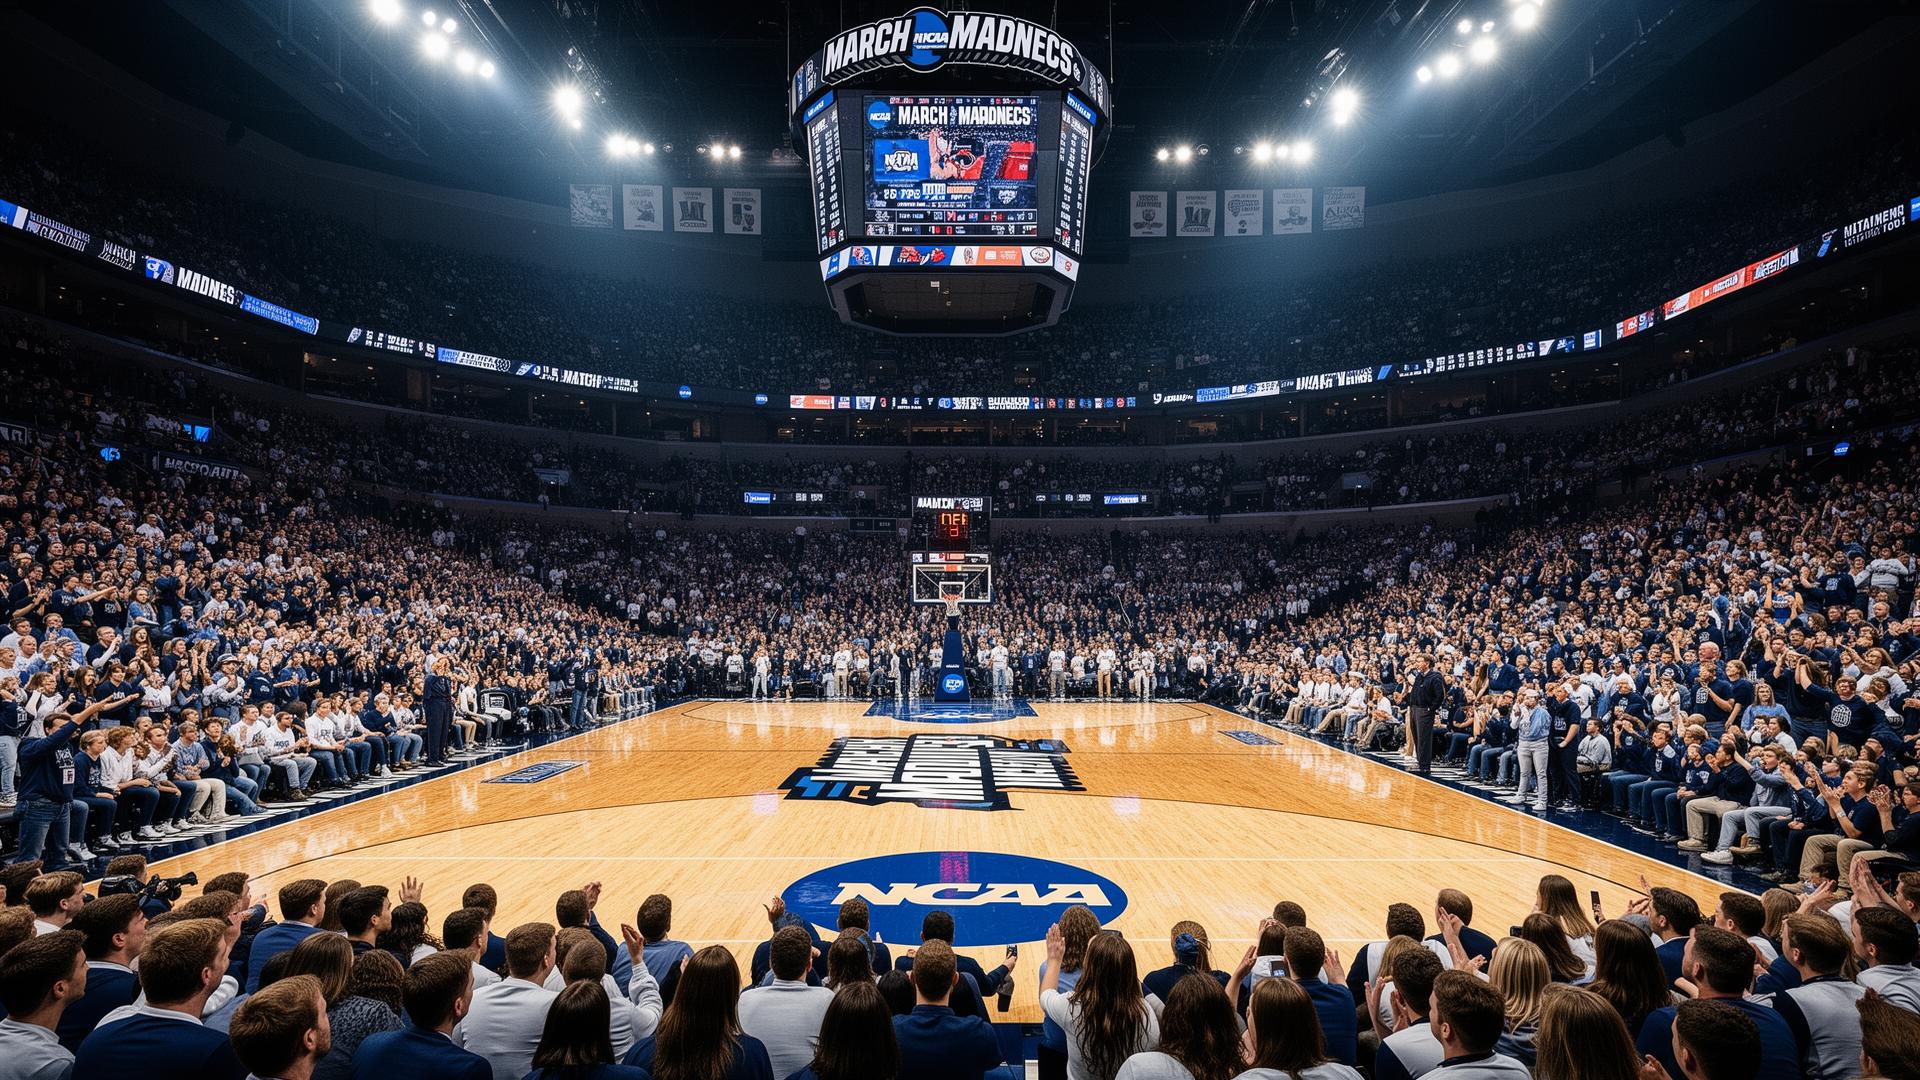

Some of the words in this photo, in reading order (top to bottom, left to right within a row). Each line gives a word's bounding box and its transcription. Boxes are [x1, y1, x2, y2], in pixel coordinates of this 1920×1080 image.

[824, 19, 912, 76] MARCH
[948, 15, 1073, 76] MADNECS
[898, 105, 947, 125] MARCH
[831, 882, 1112, 906] NCAA
